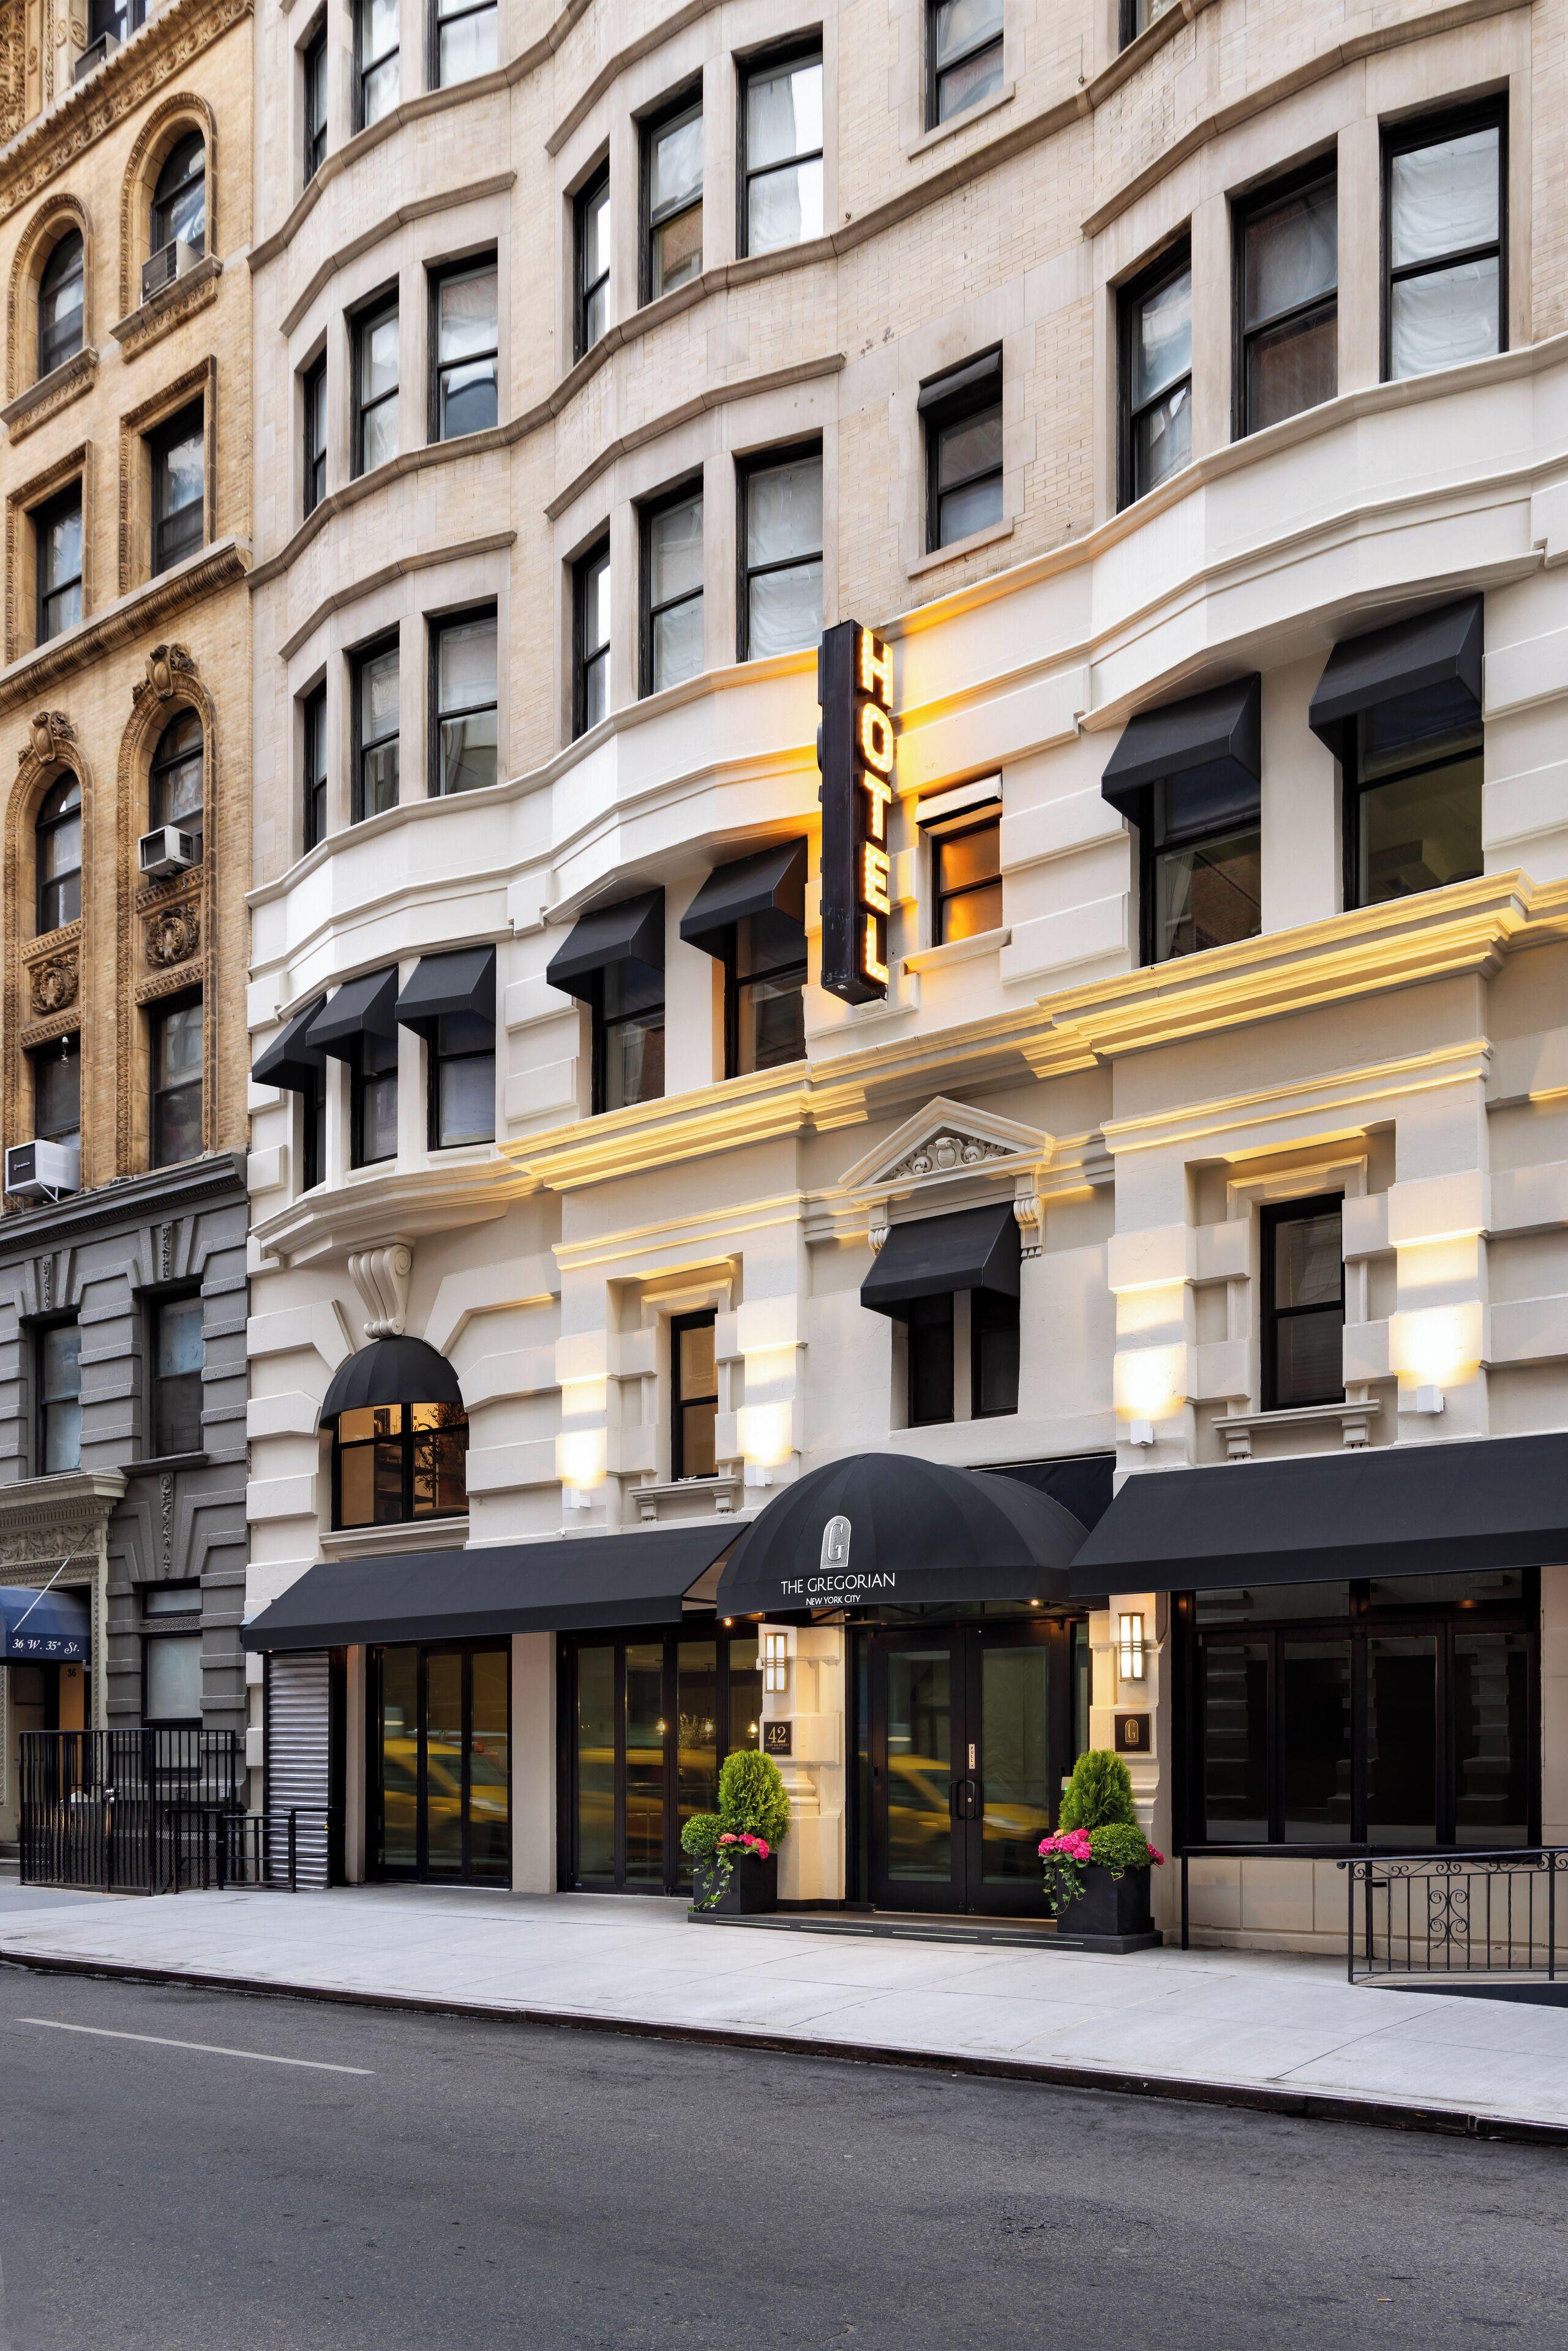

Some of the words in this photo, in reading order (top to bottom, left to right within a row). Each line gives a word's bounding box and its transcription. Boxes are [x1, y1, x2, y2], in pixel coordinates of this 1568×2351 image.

[861, 626, 894, 986] HOTEL
[781, 1579, 804, 1595] THE
[807, 1572, 895, 1592] GREGORIAN
[806, 1597, 822, 1606] NEW
[823, 1595, 843, 1605] YORK
[844, 1594, 861, 1603] CITY
[12, 1638, 24, 1649] 36
[28, 1640, 43, 1650] W.
[46, 1641, 61, 1651] 35th
[64, 1641, 80, 1654] St.
[67, 1668, 77, 1678] 36
[768, 1726, 786, 1744] 42
